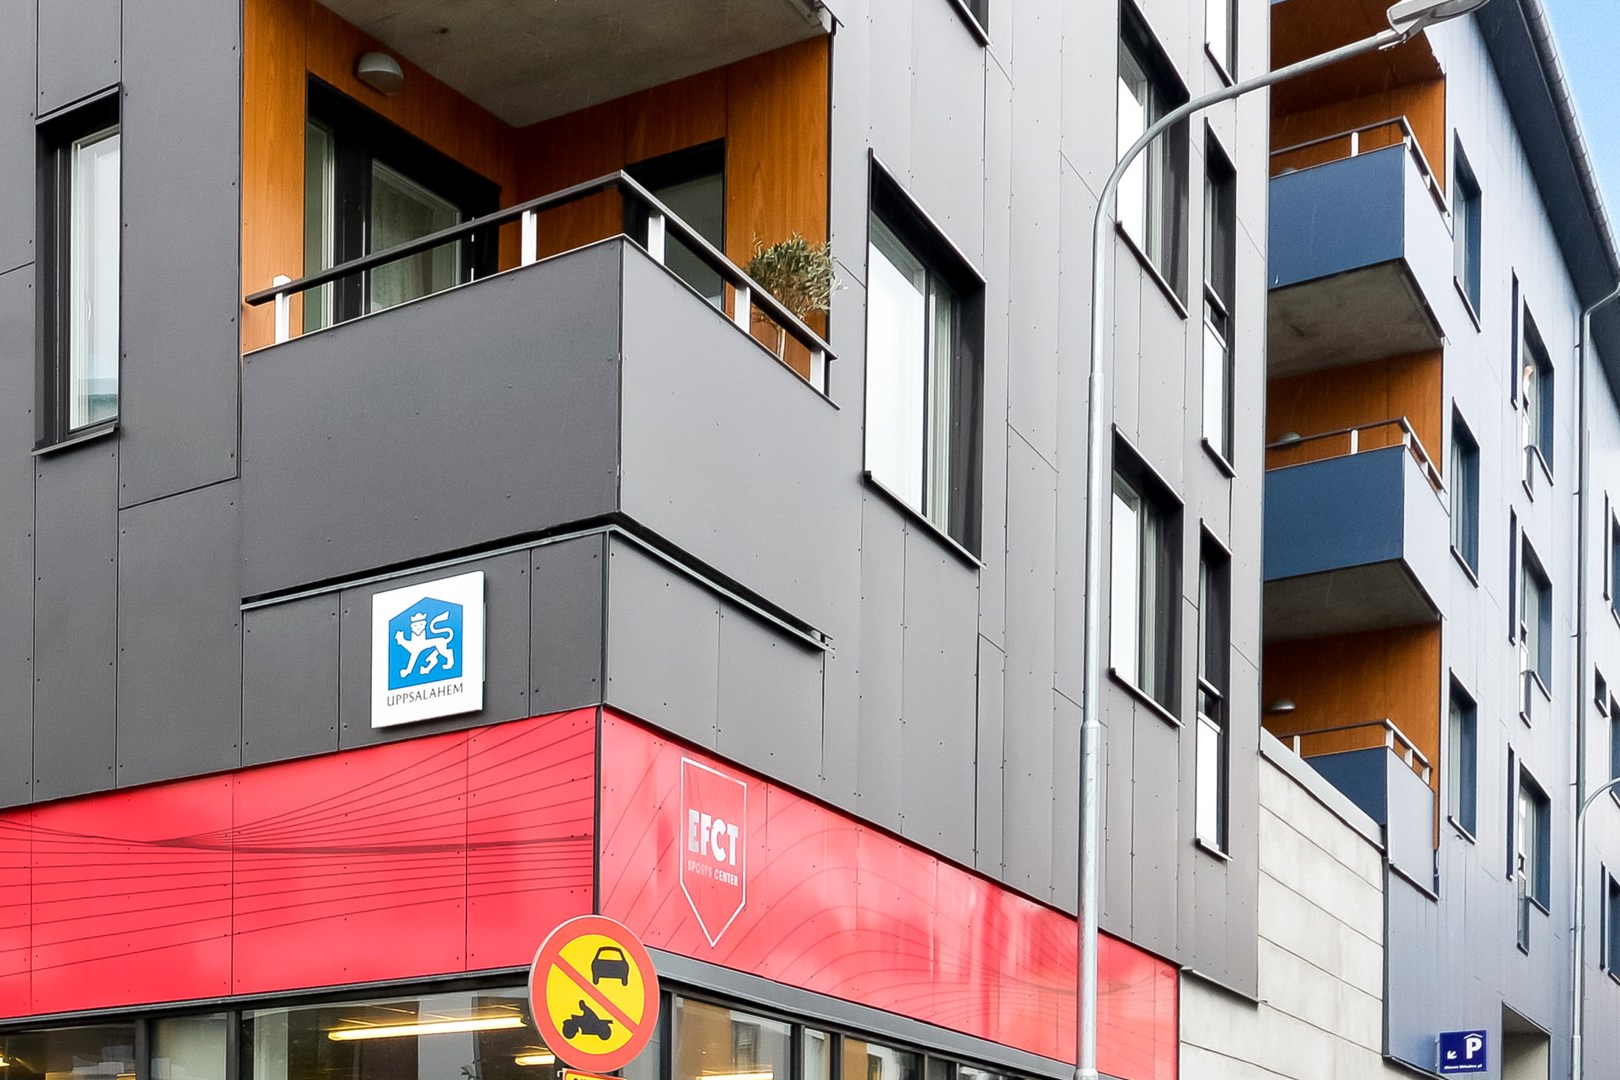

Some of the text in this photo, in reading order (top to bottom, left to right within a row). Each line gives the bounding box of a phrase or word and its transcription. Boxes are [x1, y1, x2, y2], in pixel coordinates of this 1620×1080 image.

[387, 682, 463, 707] UPPSALAHEM
[689, 808, 739, 866] EFCT
[714, 868, 739, 887] CENTER
[1466, 1037, 1482, 1059] P
